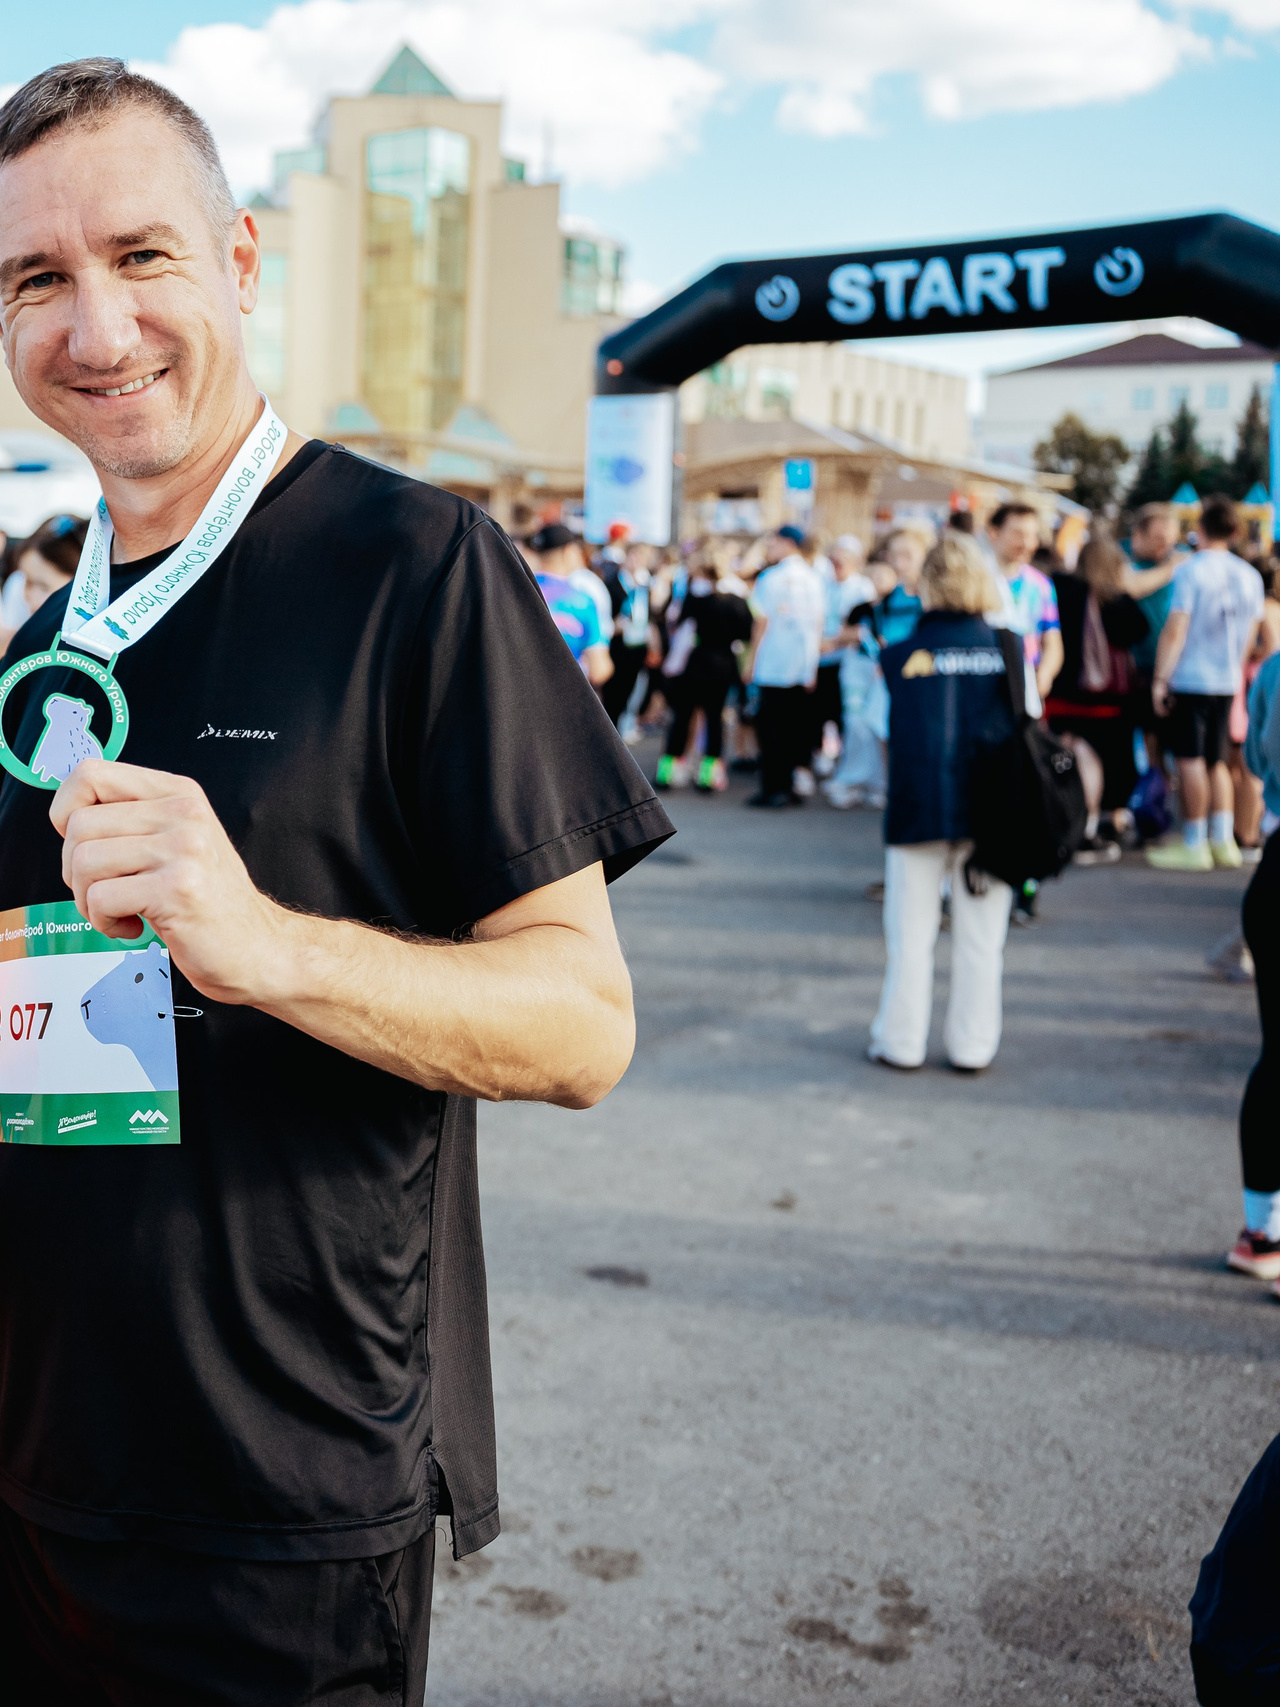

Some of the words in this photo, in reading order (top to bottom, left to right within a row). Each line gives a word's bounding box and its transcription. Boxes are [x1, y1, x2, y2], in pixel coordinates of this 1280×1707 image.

[827, 246, 1066, 325] START
[251, 420, 281, 469] Забег
[197, 467, 256, 548] волонтёров
[155, 549, 210, 593] Южного
[122, 590, 168, 625] Урала
[56, 652, 108, 682] Южного
[106, 682, 125, 723] Урала
[215, 728, 279, 740] DEMIX
[5, 922, 43, 942] волонтёров
[46, 921, 93, 935] Южного
[9, 1002, 53, 1041] 077
